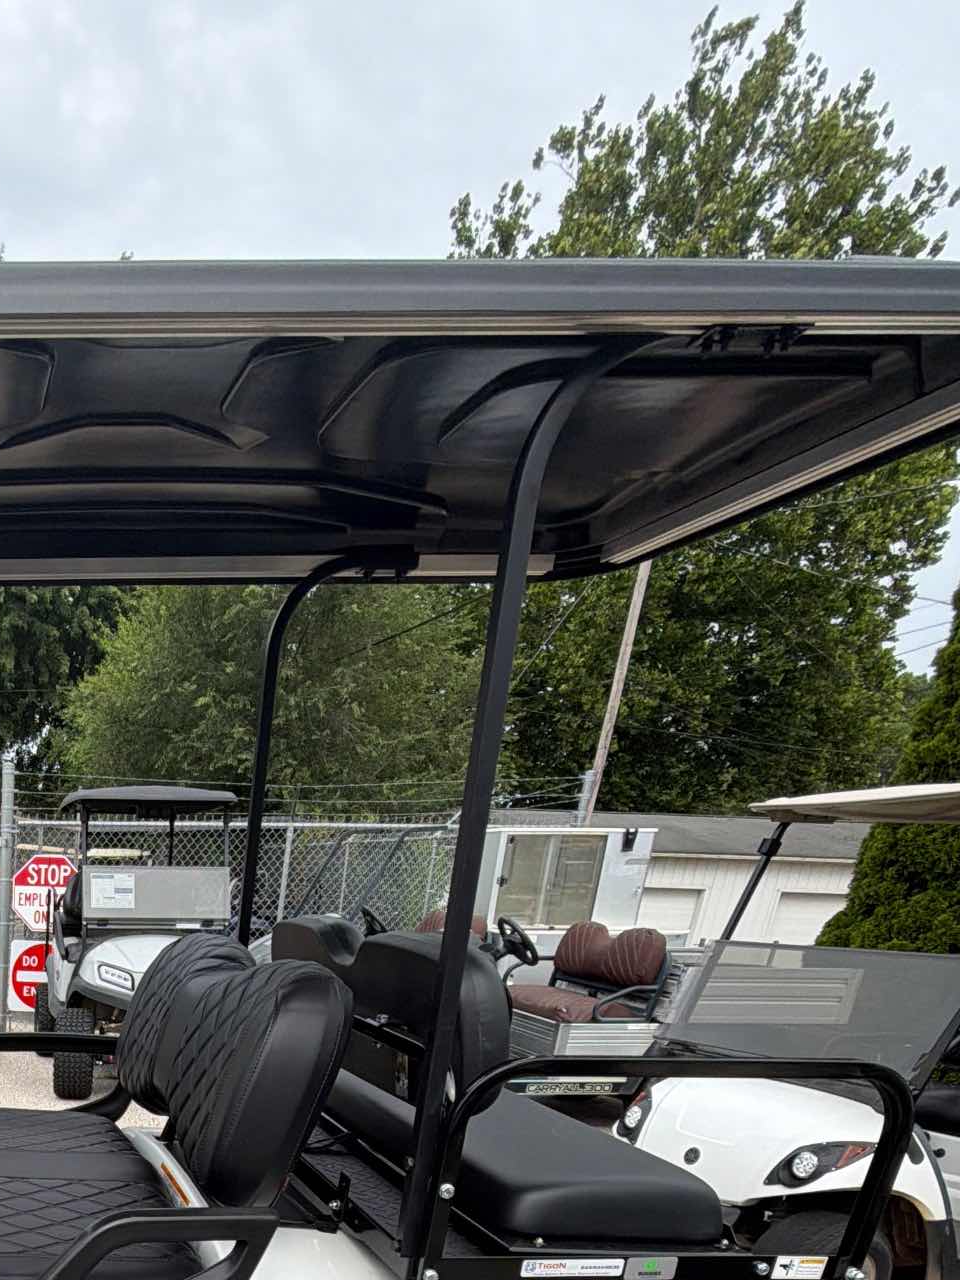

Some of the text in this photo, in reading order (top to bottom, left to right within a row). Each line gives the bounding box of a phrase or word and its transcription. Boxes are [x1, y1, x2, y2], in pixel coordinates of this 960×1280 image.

[27, 864, 71, 885] STOP
[34, 910, 48, 924] ON
[23, 955, 38, 967] DO
